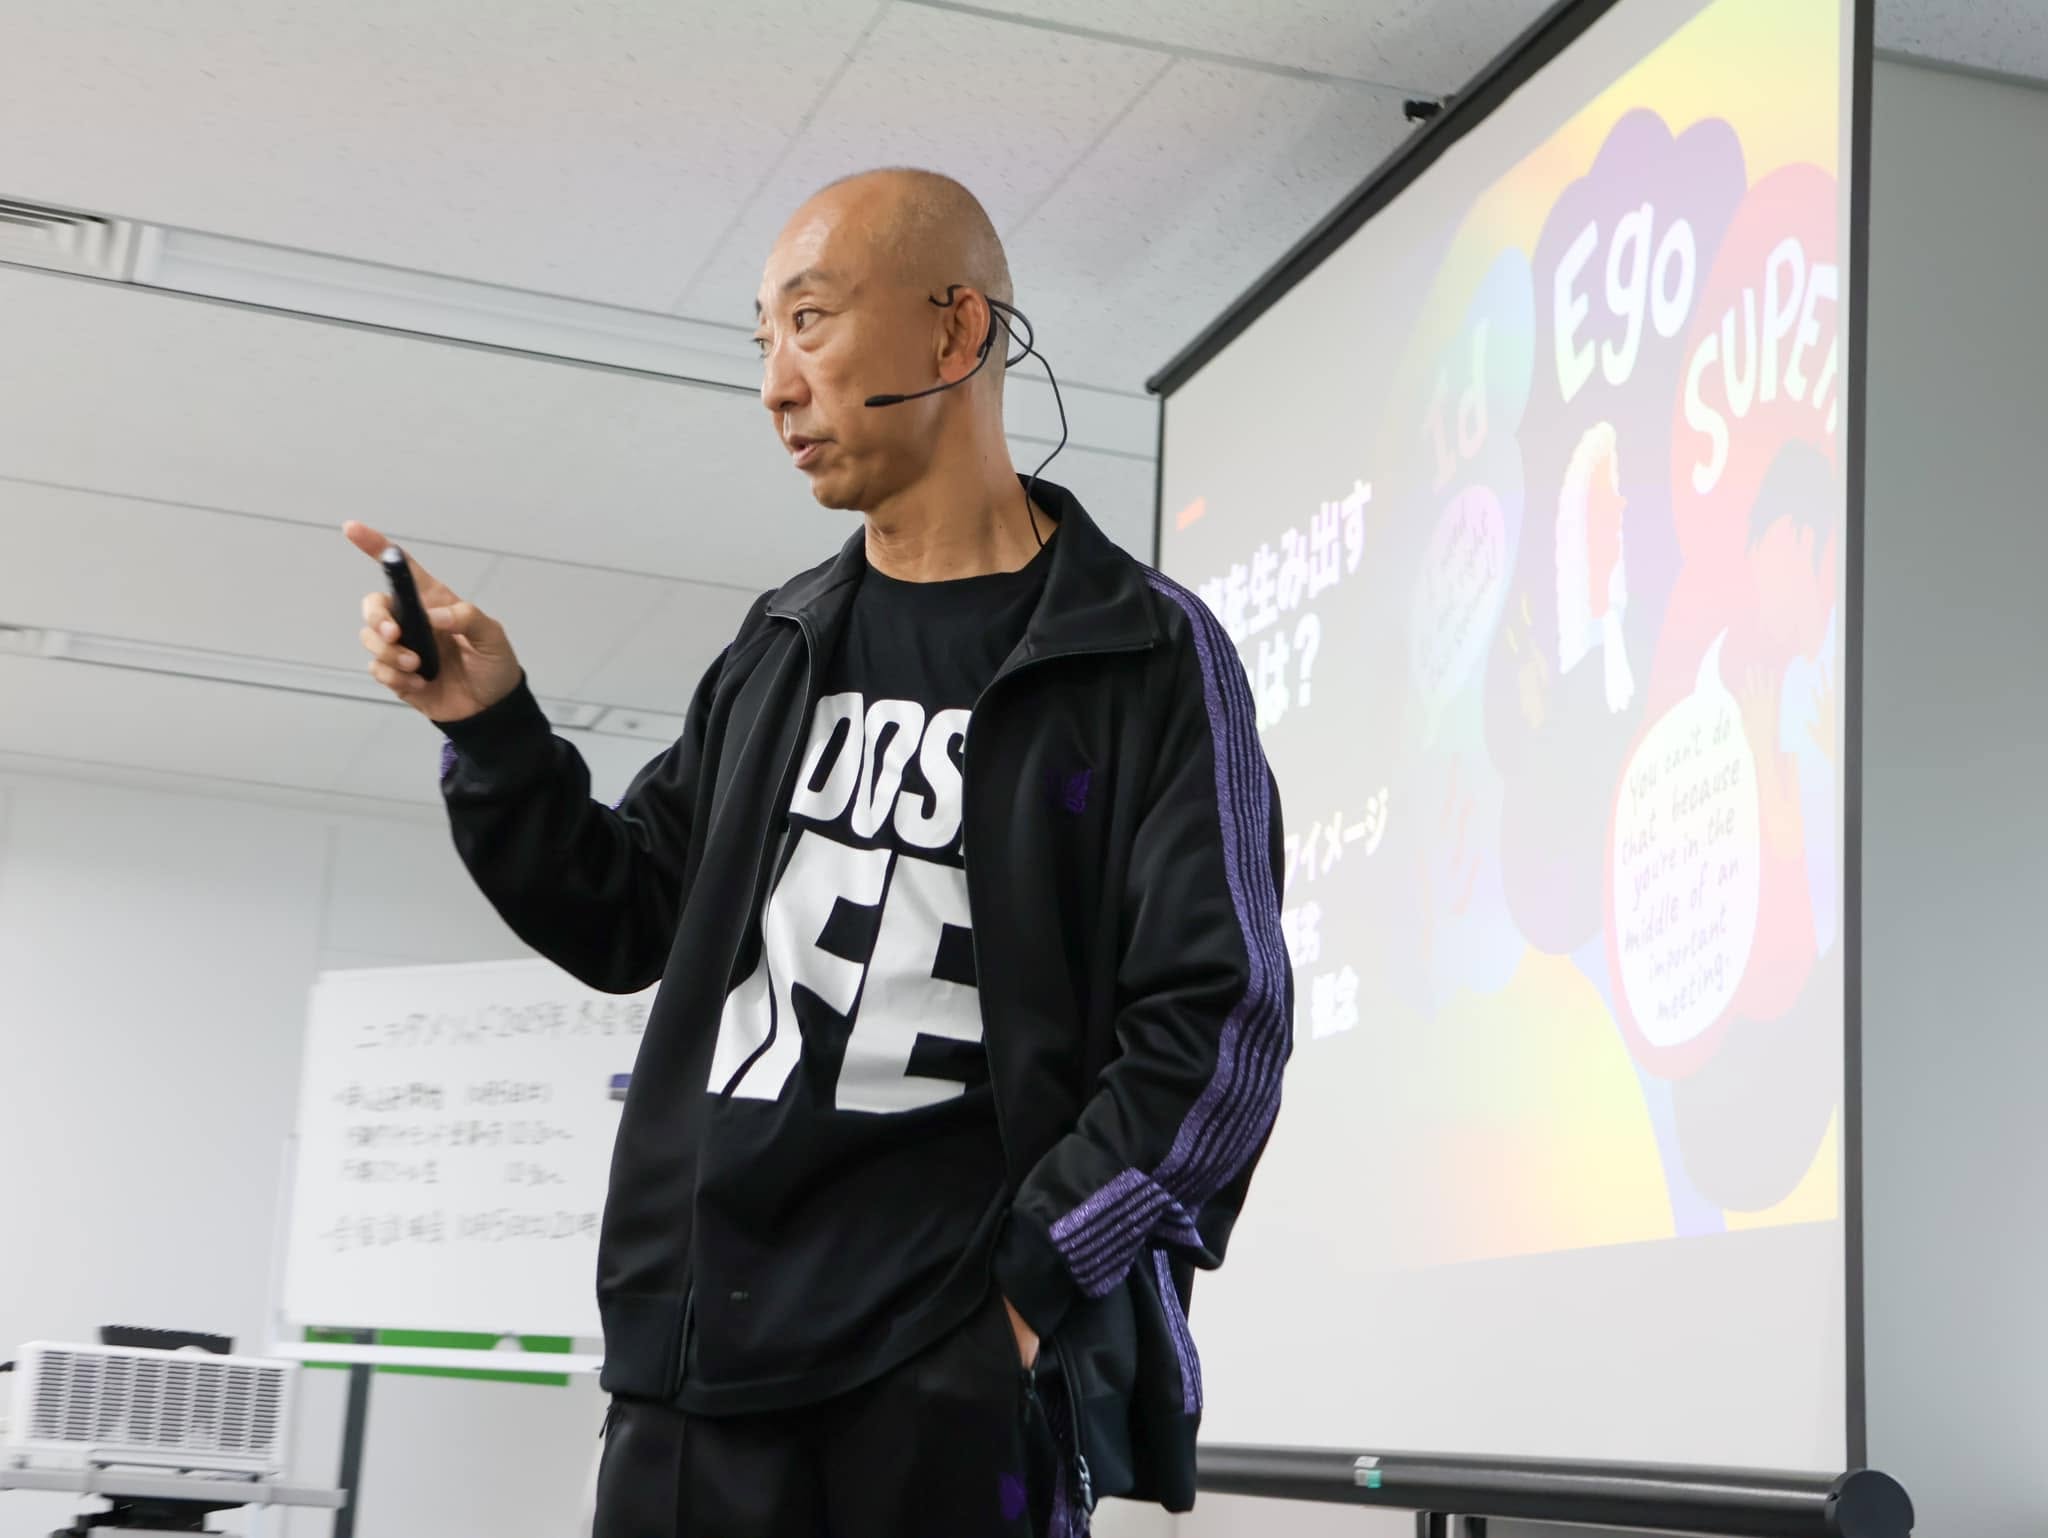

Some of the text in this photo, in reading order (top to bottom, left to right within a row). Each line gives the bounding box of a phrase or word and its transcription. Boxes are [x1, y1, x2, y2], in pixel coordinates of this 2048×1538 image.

[1552, 201, 1698, 404] Ego
[1712, 706, 1732, 746] do
[788, 691, 972, 856] DOS
[1672, 757, 1742, 822] because
[1682, 832, 1699, 865] in
[1707, 807, 1736, 848] the
[1624, 856, 1740, 954] middle of an
[1648, 903, 1728, 984] important
